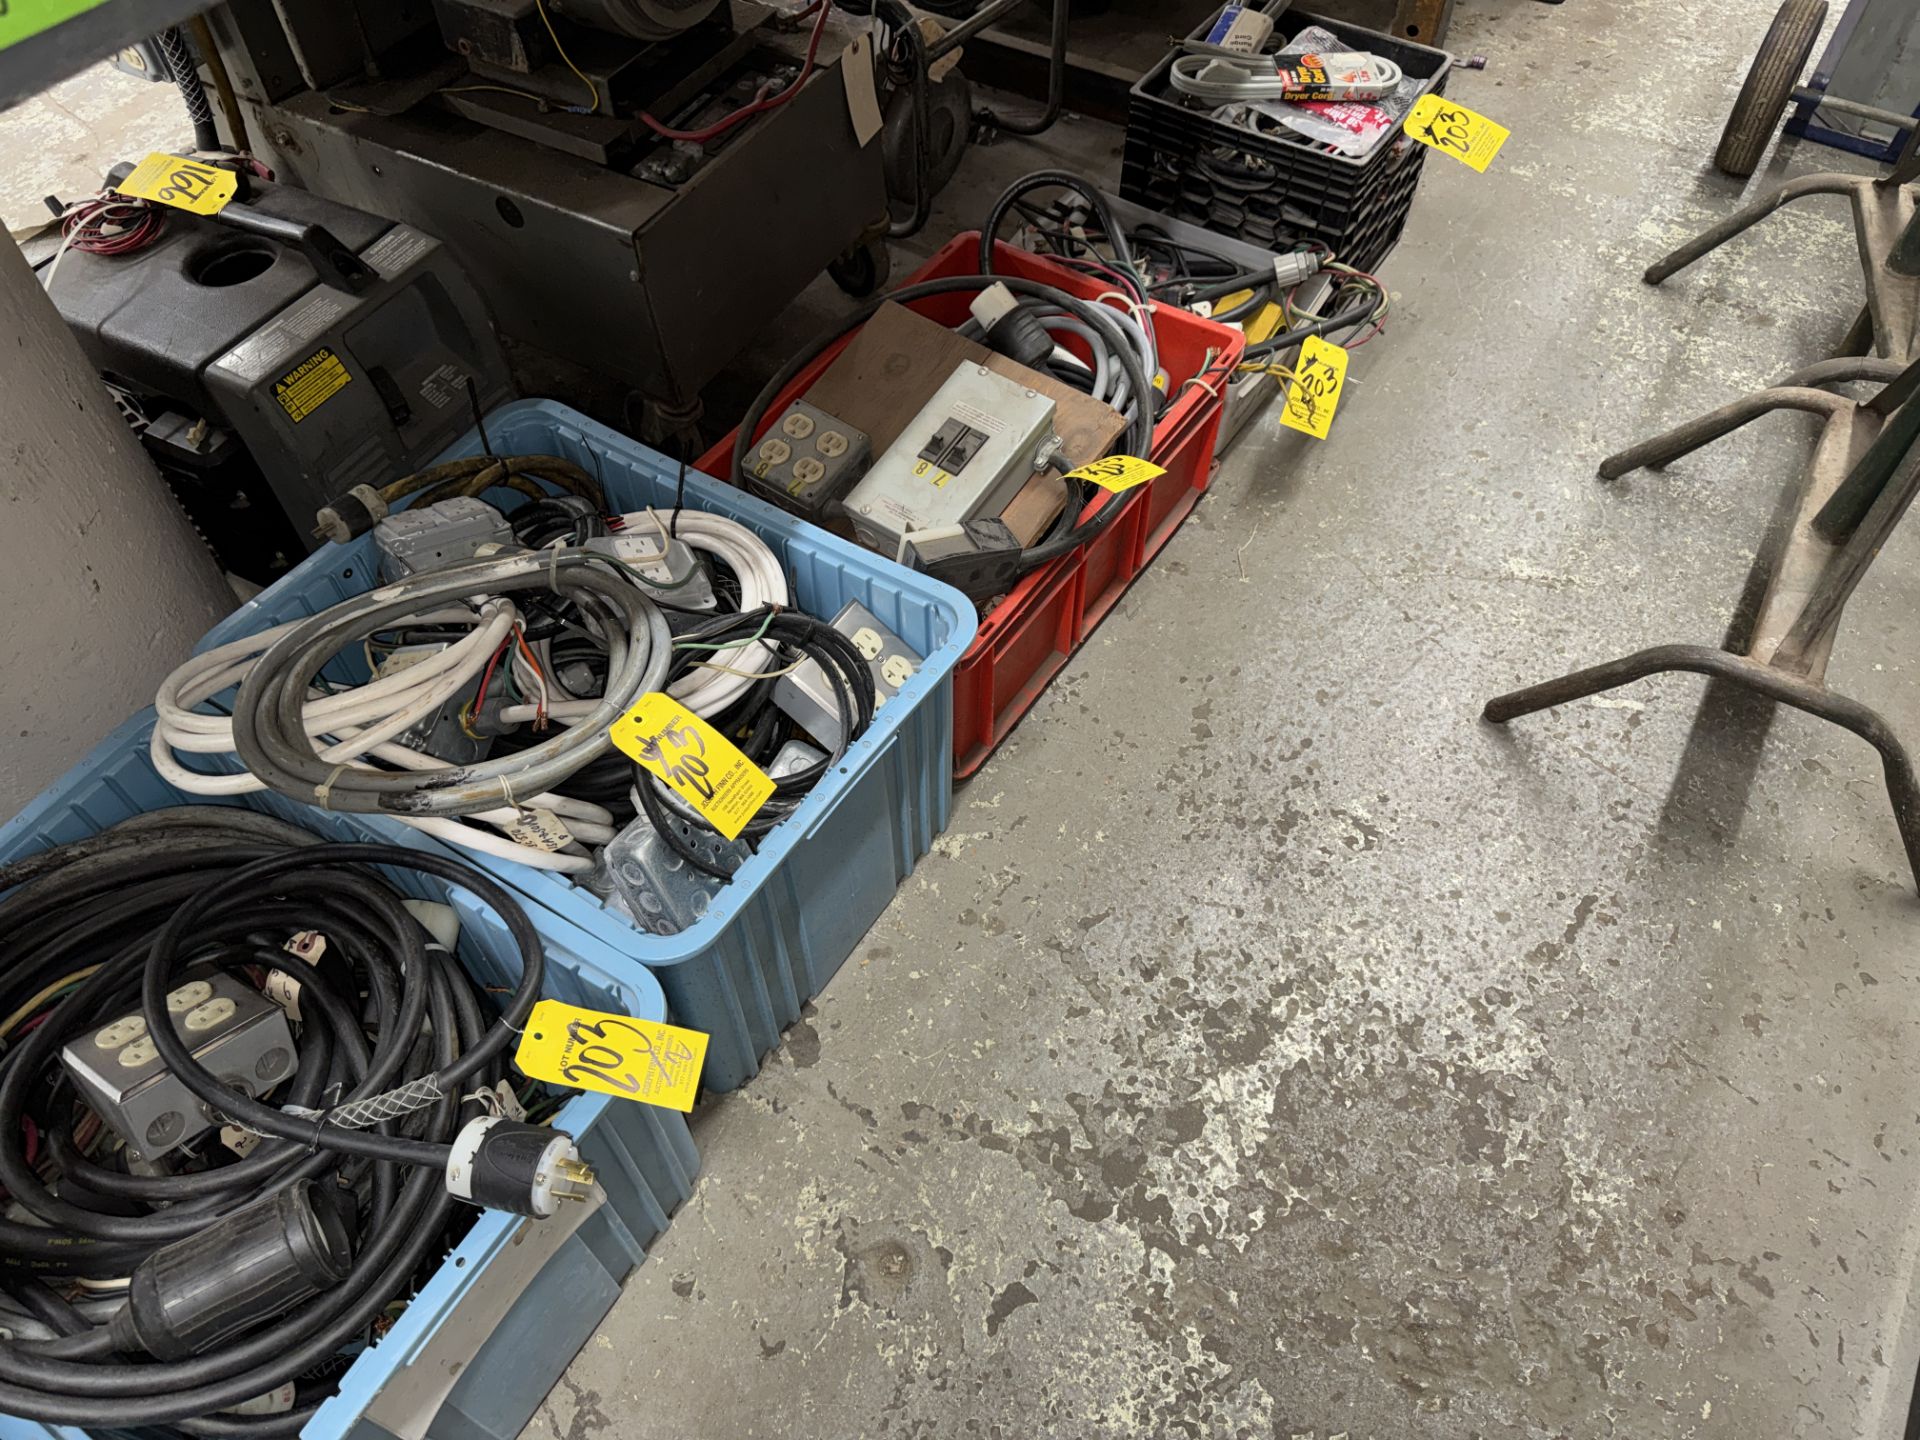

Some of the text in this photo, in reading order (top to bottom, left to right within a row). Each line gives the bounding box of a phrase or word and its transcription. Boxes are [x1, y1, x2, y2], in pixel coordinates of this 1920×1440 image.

[1284, 92, 1334, 101] Dryer Cord
[1440, 110, 1470, 153] 203
[285, 350, 329, 384] WARNING
[918, 463, 928, 473] 8
[654, 713, 682, 743] NUMBER
[667, 725, 715, 800] 203
[701, 791, 719, 810] JOSH
[715, 779, 727, 793] FINN
[563, 1020, 653, 1093] 203
